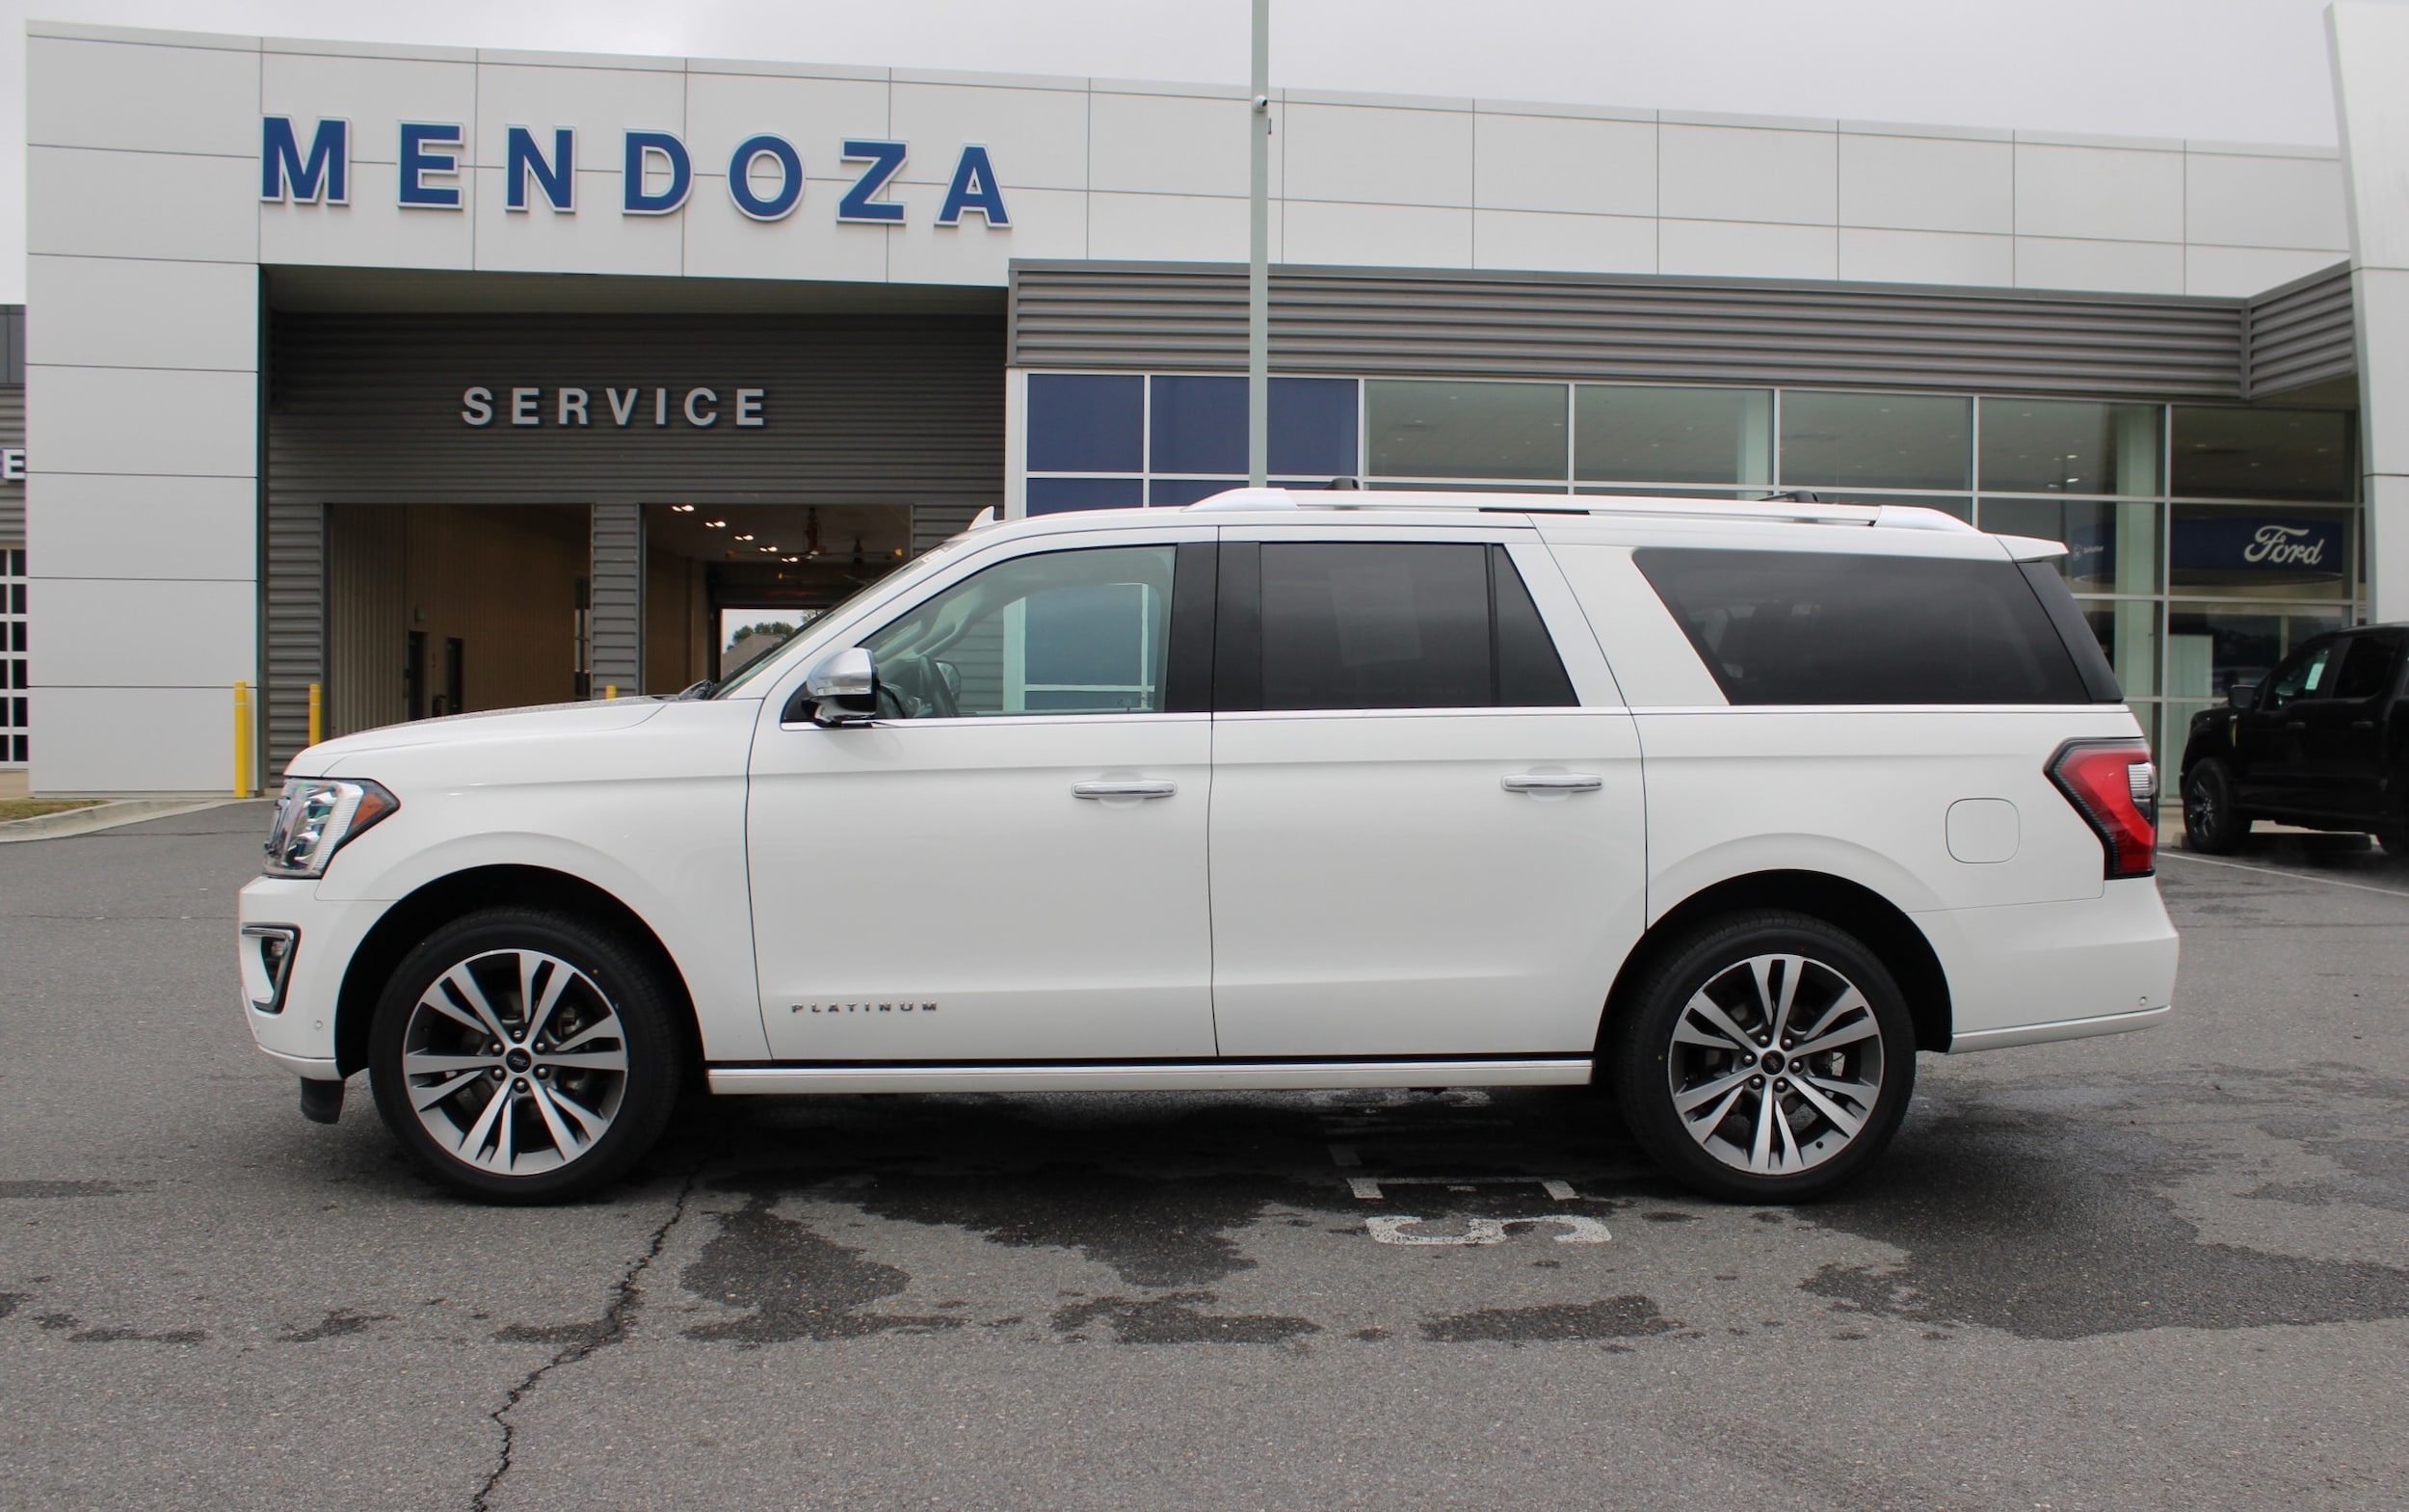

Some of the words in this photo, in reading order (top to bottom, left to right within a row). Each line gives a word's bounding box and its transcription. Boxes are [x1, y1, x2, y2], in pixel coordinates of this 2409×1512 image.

[260, 115, 1012, 227] MENDOZA
[461, 385, 766, 428] SERVICE
[2244, 524, 2325, 566] Ford
[790, 1002, 938, 1013] PLATINUM
